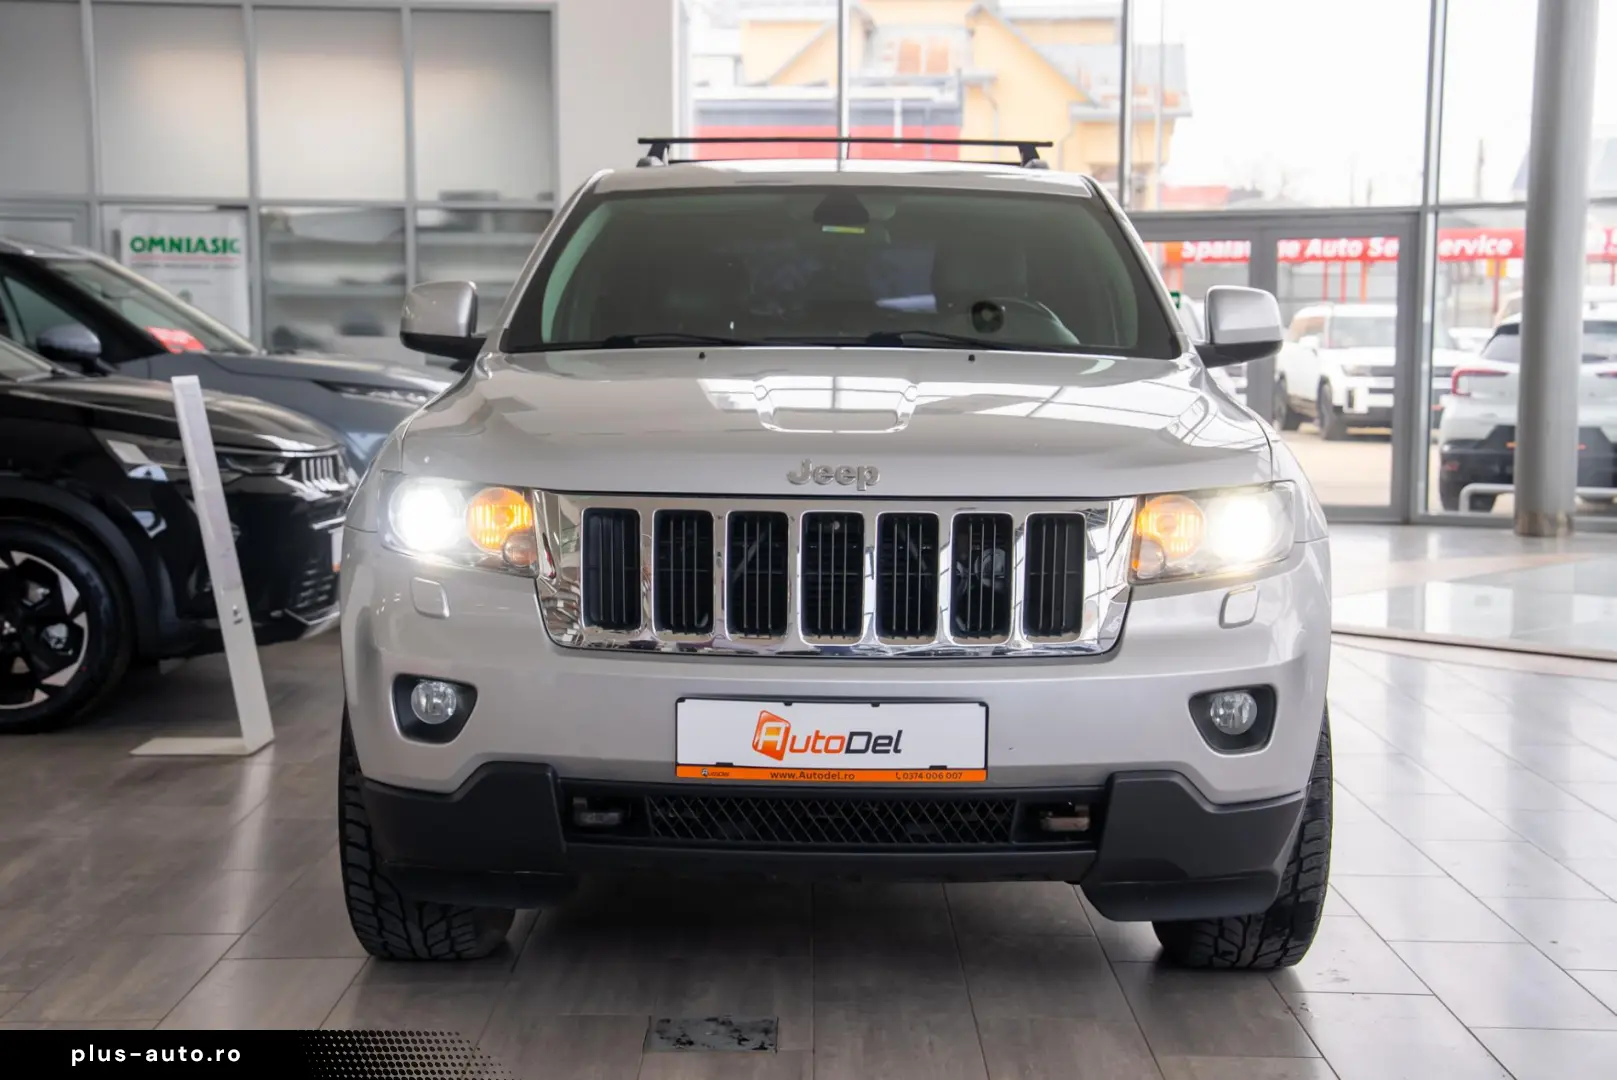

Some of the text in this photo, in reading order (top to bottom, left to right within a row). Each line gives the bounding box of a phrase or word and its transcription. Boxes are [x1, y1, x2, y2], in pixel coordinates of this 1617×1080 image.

[1304, 237, 1364, 259] Auto
[1438, 234, 1514, 256] ervice
[786, 459, 881, 491] Jeep
[753, 712, 903, 760] AutoDel
[770, 770, 855, 781] www.Autodel.ro
[902, 772, 963, 781] 0374 006 007
